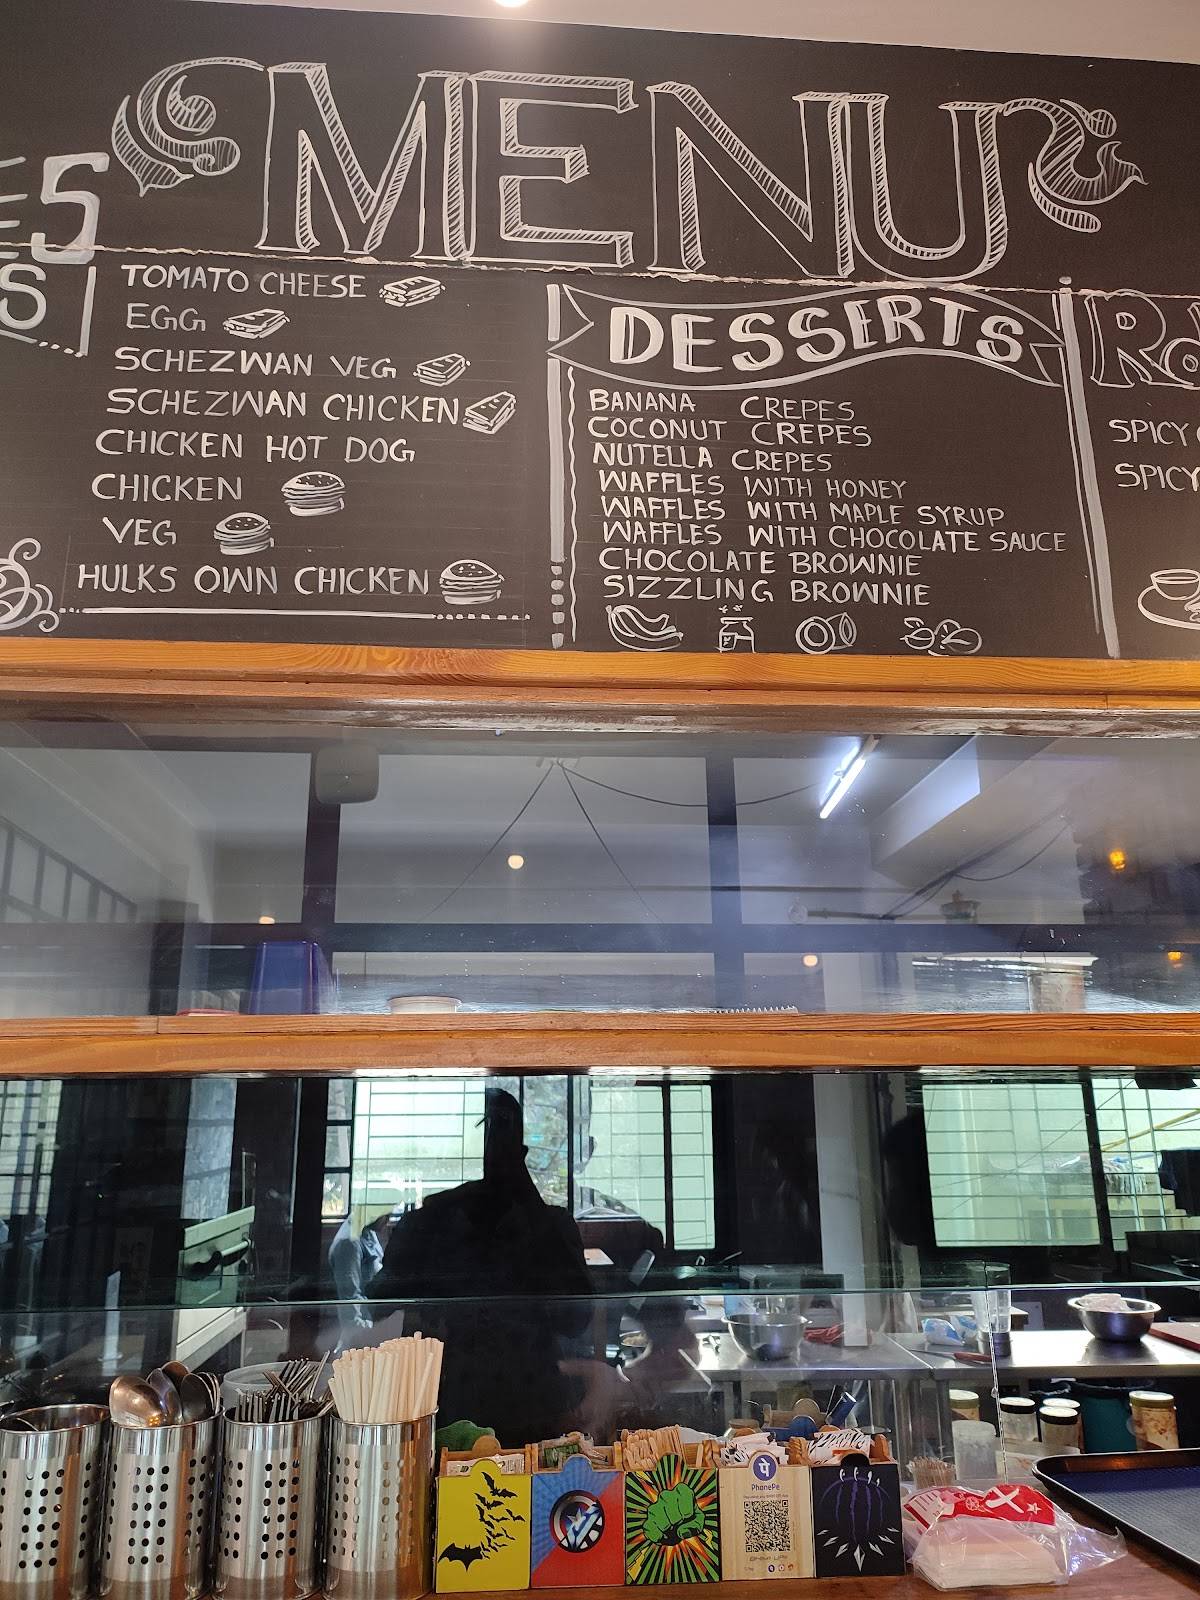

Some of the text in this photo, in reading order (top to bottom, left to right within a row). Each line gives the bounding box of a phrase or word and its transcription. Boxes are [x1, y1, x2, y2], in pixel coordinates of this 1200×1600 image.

[257, 62, 1007, 282] MENU
[121, 265, 366, 298] TOMATO CHEESE
[127, 303, 205, 331] EGG
[608, 294, 1024, 374] DESSERTS
[115, 347, 396, 379] SCHEZWAN VEG
[107, 388, 459, 424] SCHEZWAN CHICKEN
[589, 389, 854, 421] BANANA CREPES
[96, 429, 415, 463] CHICKEN HOT DOG
[588, 416, 871, 446] COCONUT CREPES
[1109, 420, 1189, 446] SPICY
[591, 440, 832, 473] NUTELLA CREPES
[92, 474, 241, 502] CHICKEN
[599, 470, 906, 499] WAFFLES WITH HONEY
[1115, 463, 1200, 491] SPICY
[601, 495, 1004, 527] WAFFLES WITH MAPLE SYRUP
[103, 517, 176, 545] VEG
[603, 520, 1066, 553] WAFFLES WITH CHOCOLATE SAUCE
[599, 547, 922, 576] CHOCOLATE BROWNIE
[78, 564, 428, 595] HULKS OWN CHICKEN
[603, 575, 929, 605] SIZZLING BROWNIE
[751, 1483, 780, 1491] PhonePe
